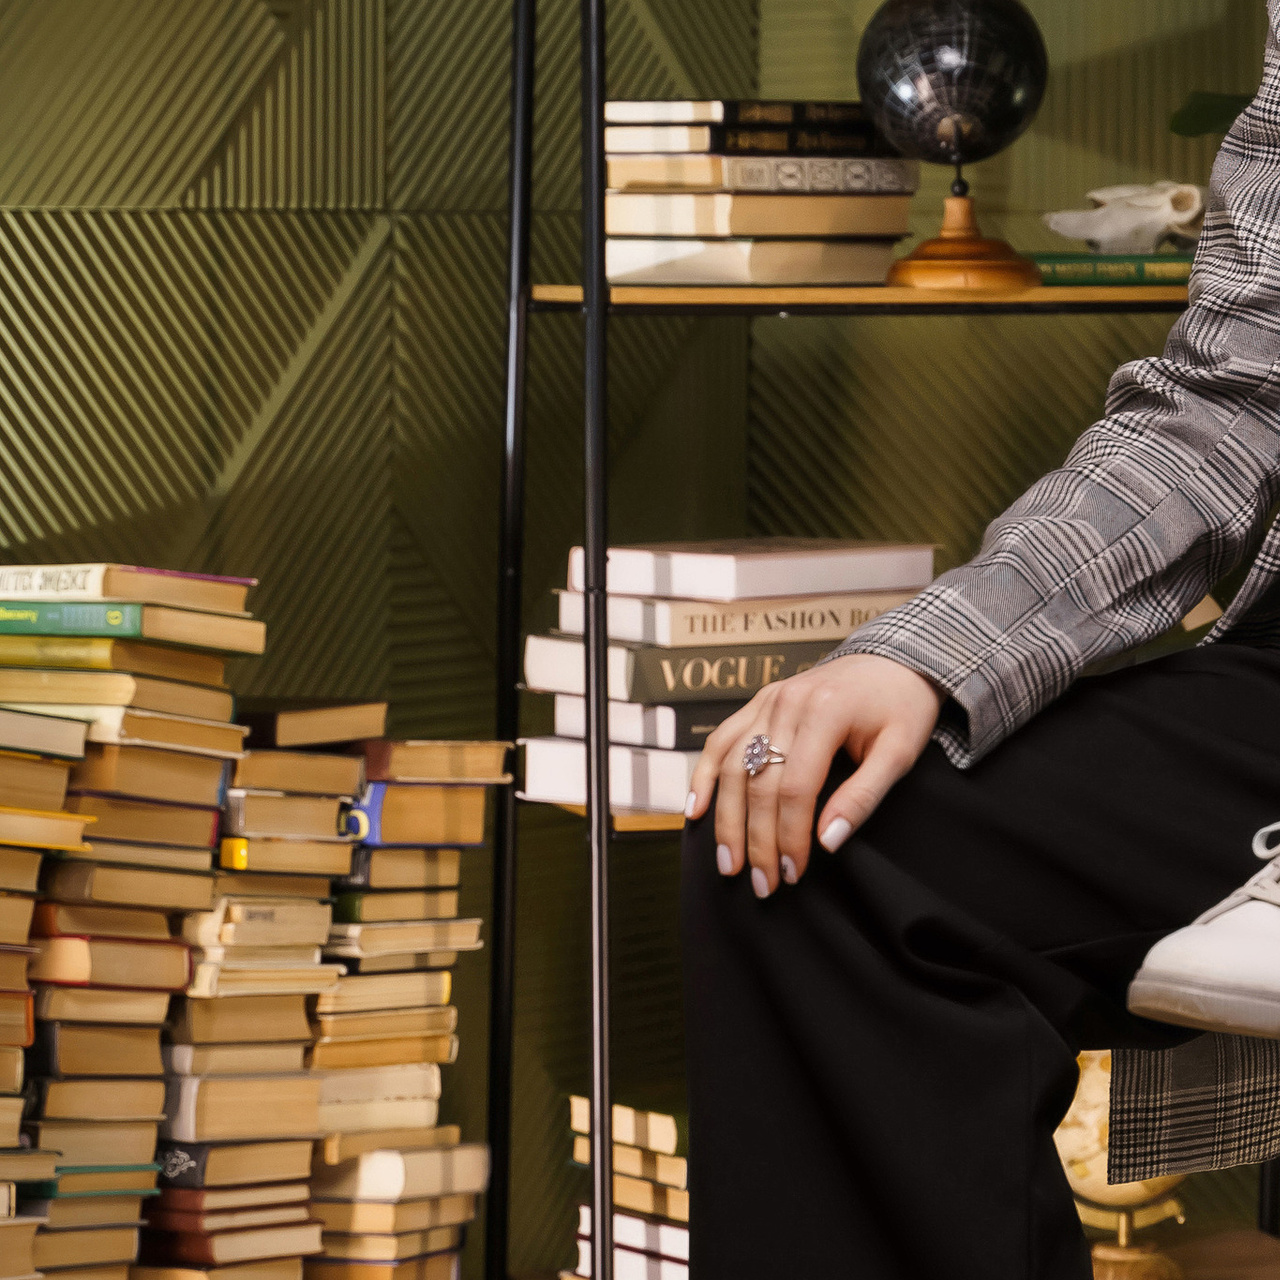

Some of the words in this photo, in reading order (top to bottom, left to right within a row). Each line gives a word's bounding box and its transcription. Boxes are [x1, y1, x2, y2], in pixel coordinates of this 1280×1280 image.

[685, 612, 735, 635] THE
[743, 606, 842, 632] FASHION
[660, 653, 786, 692] VOGUE
